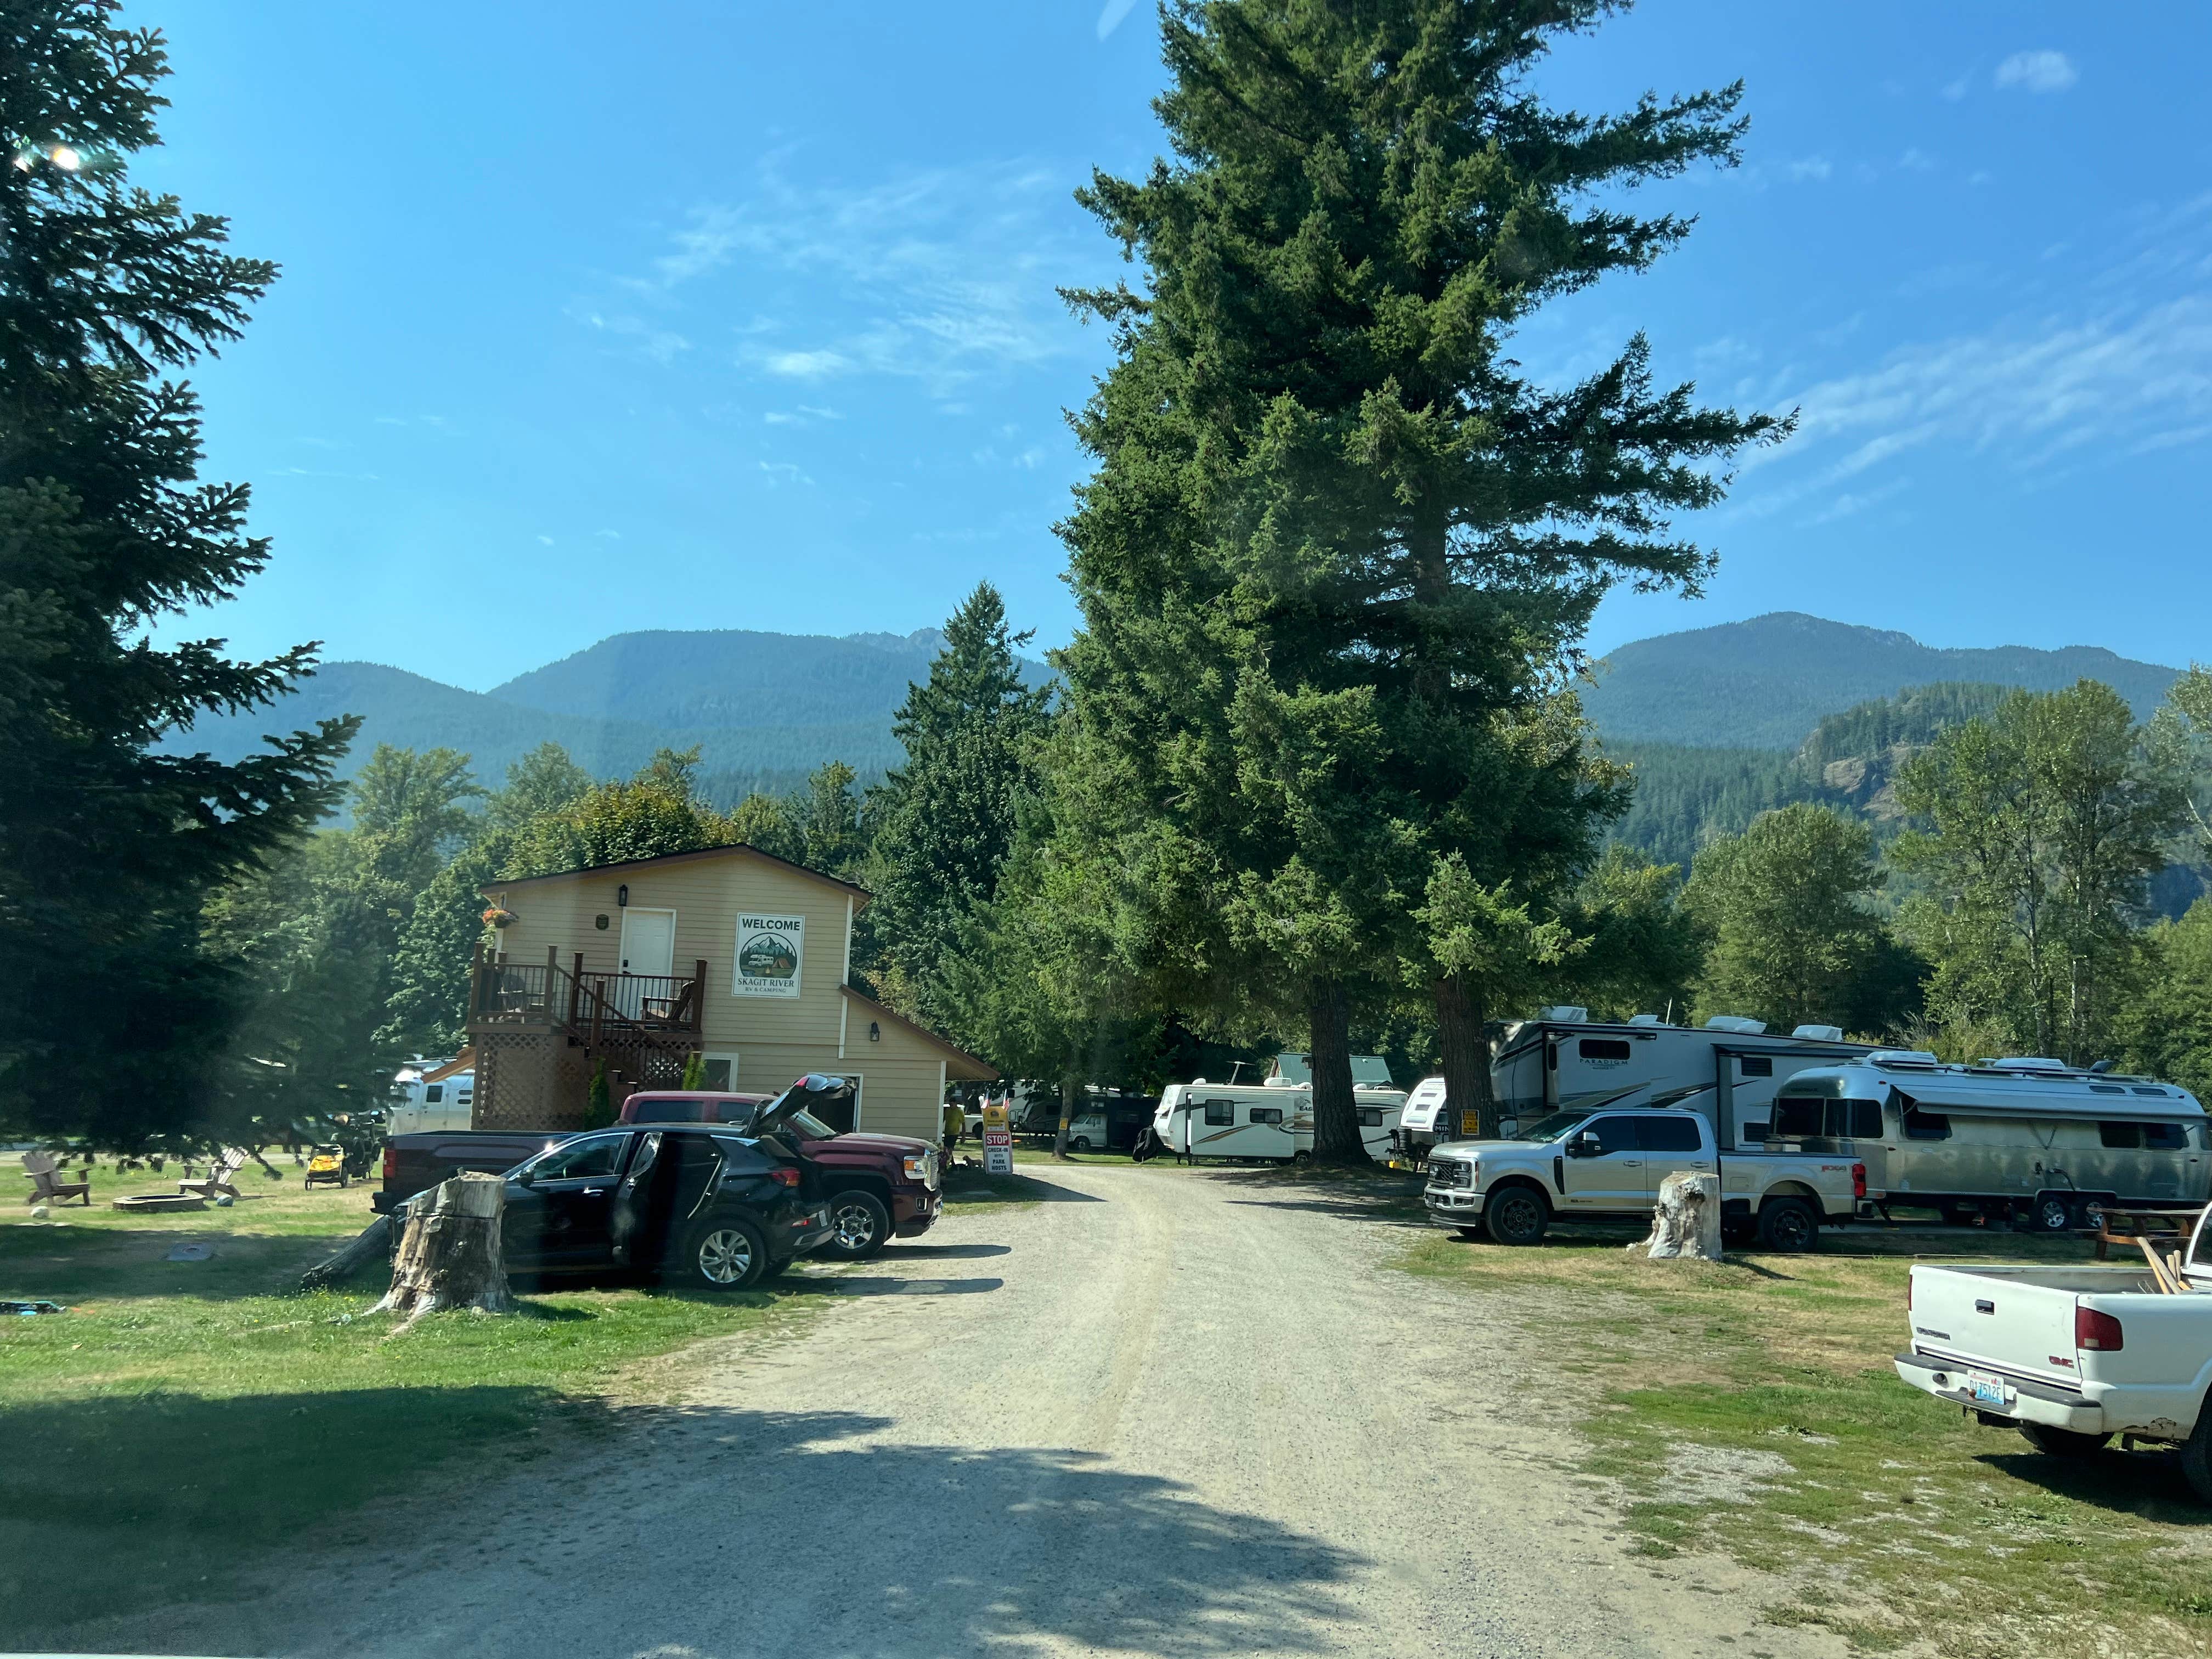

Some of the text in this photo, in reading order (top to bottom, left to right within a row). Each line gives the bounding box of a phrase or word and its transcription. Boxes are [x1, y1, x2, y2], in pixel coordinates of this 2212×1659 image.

[742, 918, 800, 930] WELCOME
[770, 979, 794, 988] RIVER
[986, 1135, 1008, 1144] STOP
[2049, 1356, 2075, 1369] GMC
